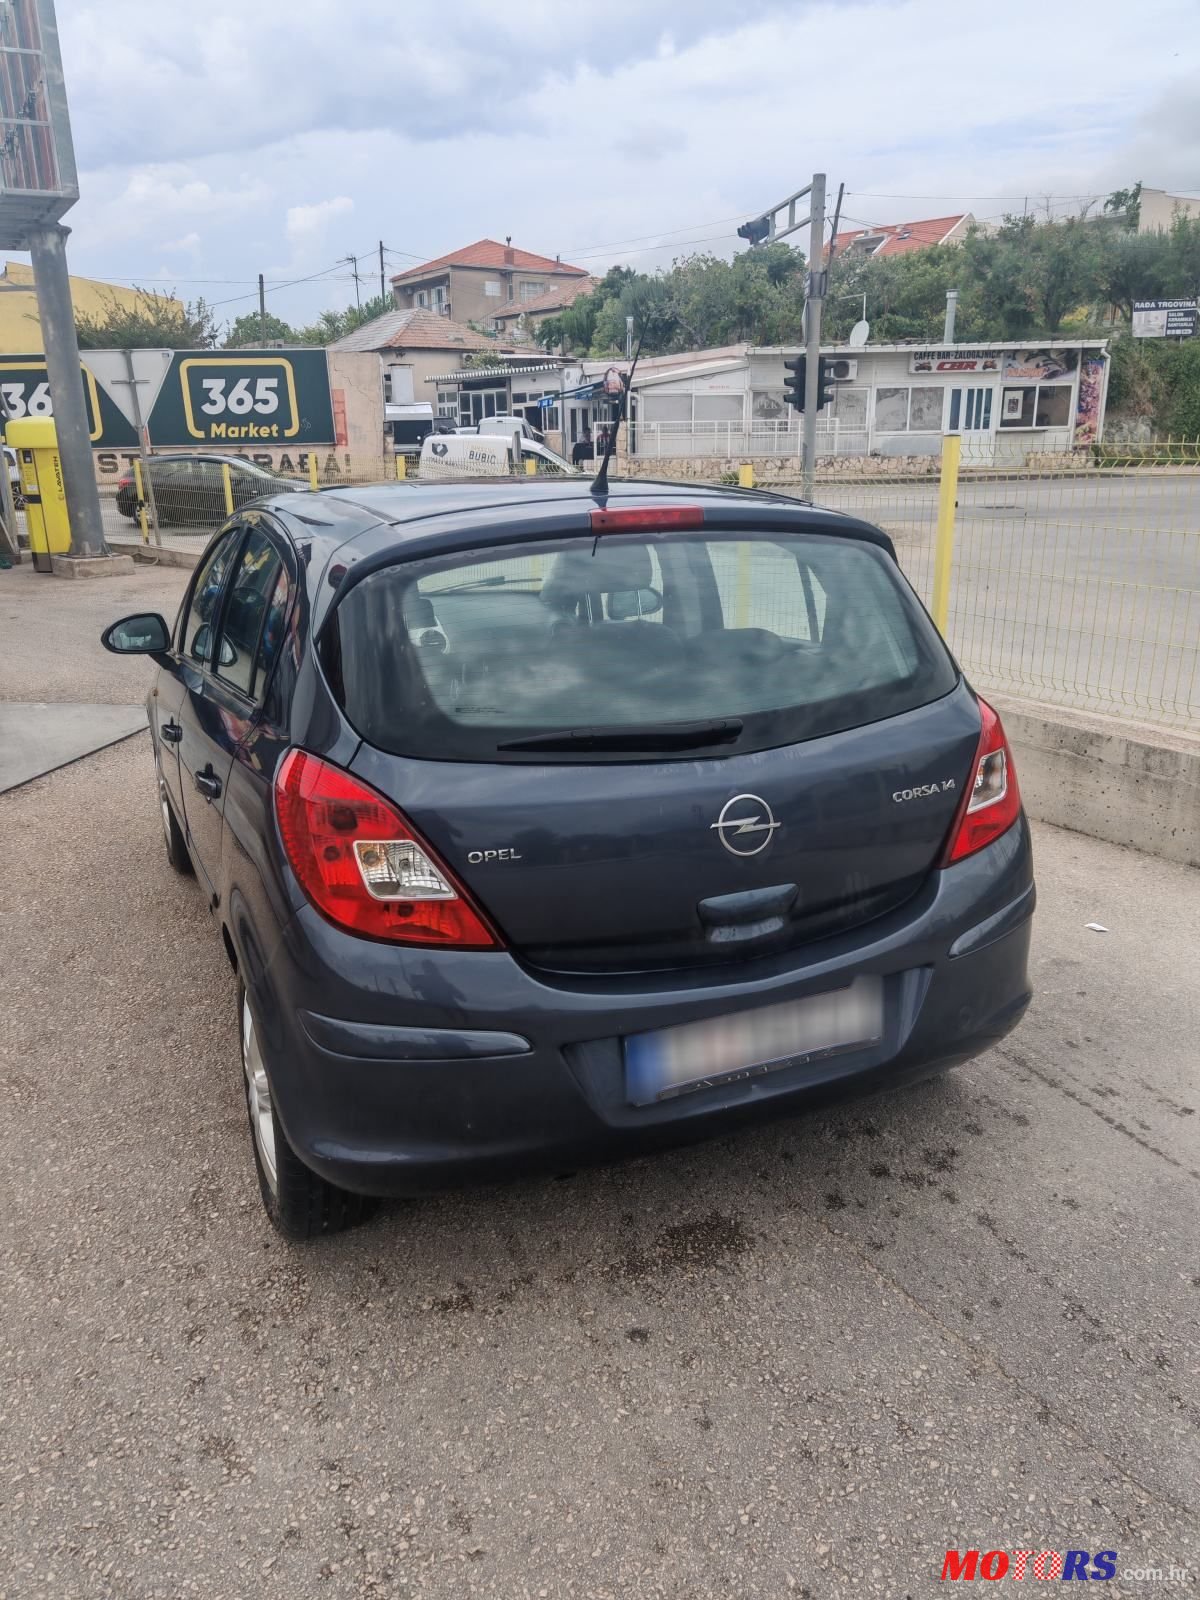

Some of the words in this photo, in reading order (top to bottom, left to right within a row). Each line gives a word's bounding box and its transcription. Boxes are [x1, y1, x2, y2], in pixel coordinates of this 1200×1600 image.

[913, 351, 936, 360] CAFFE
[1, 383, 54, 420] 36
[201, 378, 279, 415] 365
[210, 422, 279, 438] Market
[893, 784, 940, 802] CORSA
[468, 848, 522, 863] OPEL
